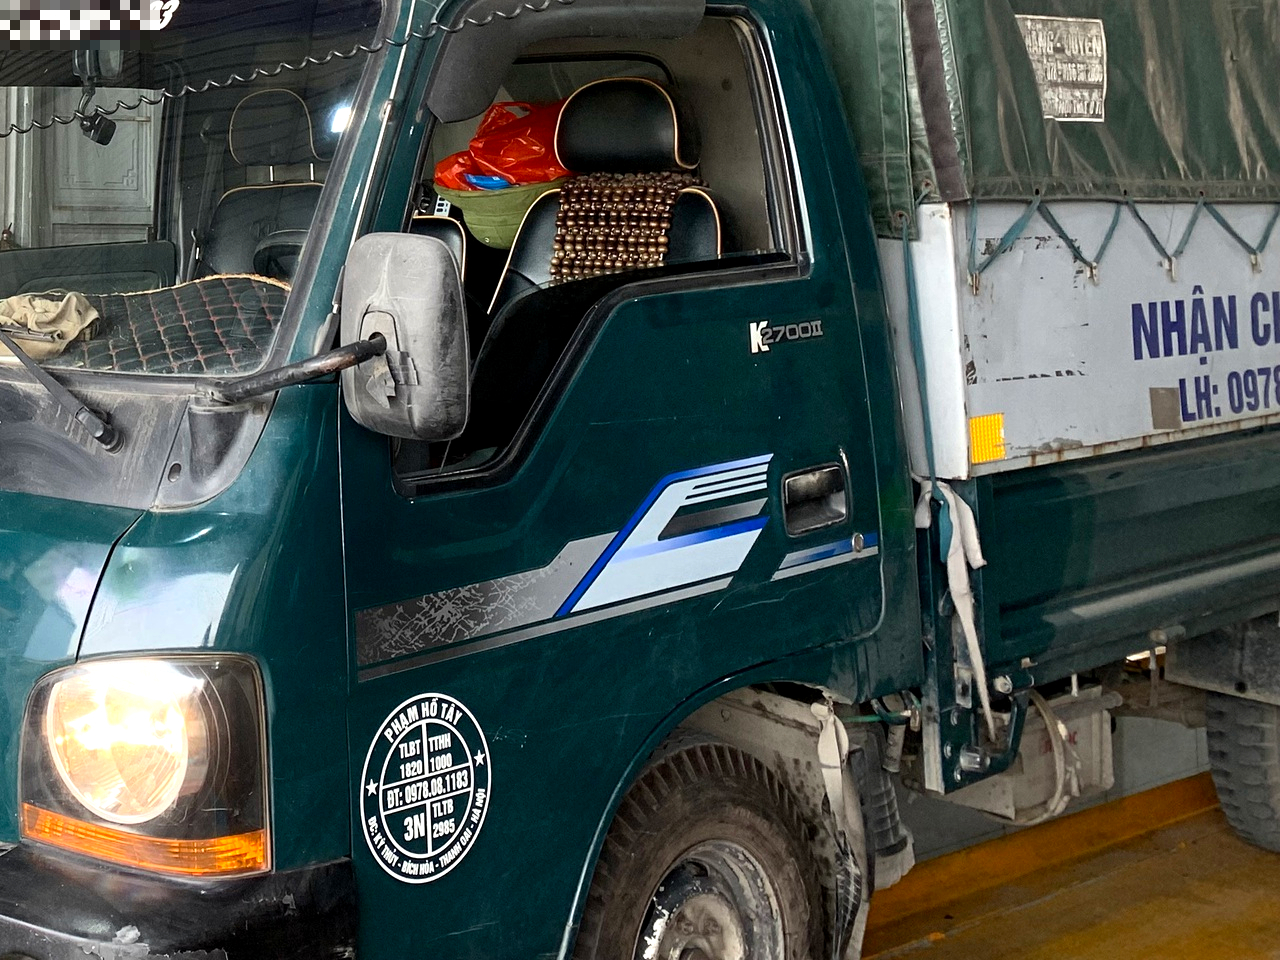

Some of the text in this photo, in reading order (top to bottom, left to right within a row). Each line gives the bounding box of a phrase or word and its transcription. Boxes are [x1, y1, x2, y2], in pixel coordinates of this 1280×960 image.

[1132, 285, 1238, 365] NHẬN
[1179, 375, 1221, 422] LH:
[384, 705, 419, 743] PHẠM
[441, 703, 463, 725] TÂY
[399, 739, 420, 759] TLBT
[428, 733, 451, 752] TTHH
[400, 760, 422, 779] 1820
[430, 753, 452, 771] 1000
[387, 770, 468, 809] ĐT: 0978.08.1183
[432, 799, 454, 818] TLTB
[368, 816, 378, 836] ĐC:
[401, 860, 419, 875] BÍCH
[439, 842, 462, 867] THANH
[460, 829, 472, 846] OAI
[476, 788, 486, 807] NỘI
[404, 813, 425, 841] 3N
[433, 818, 455, 838] 2985
